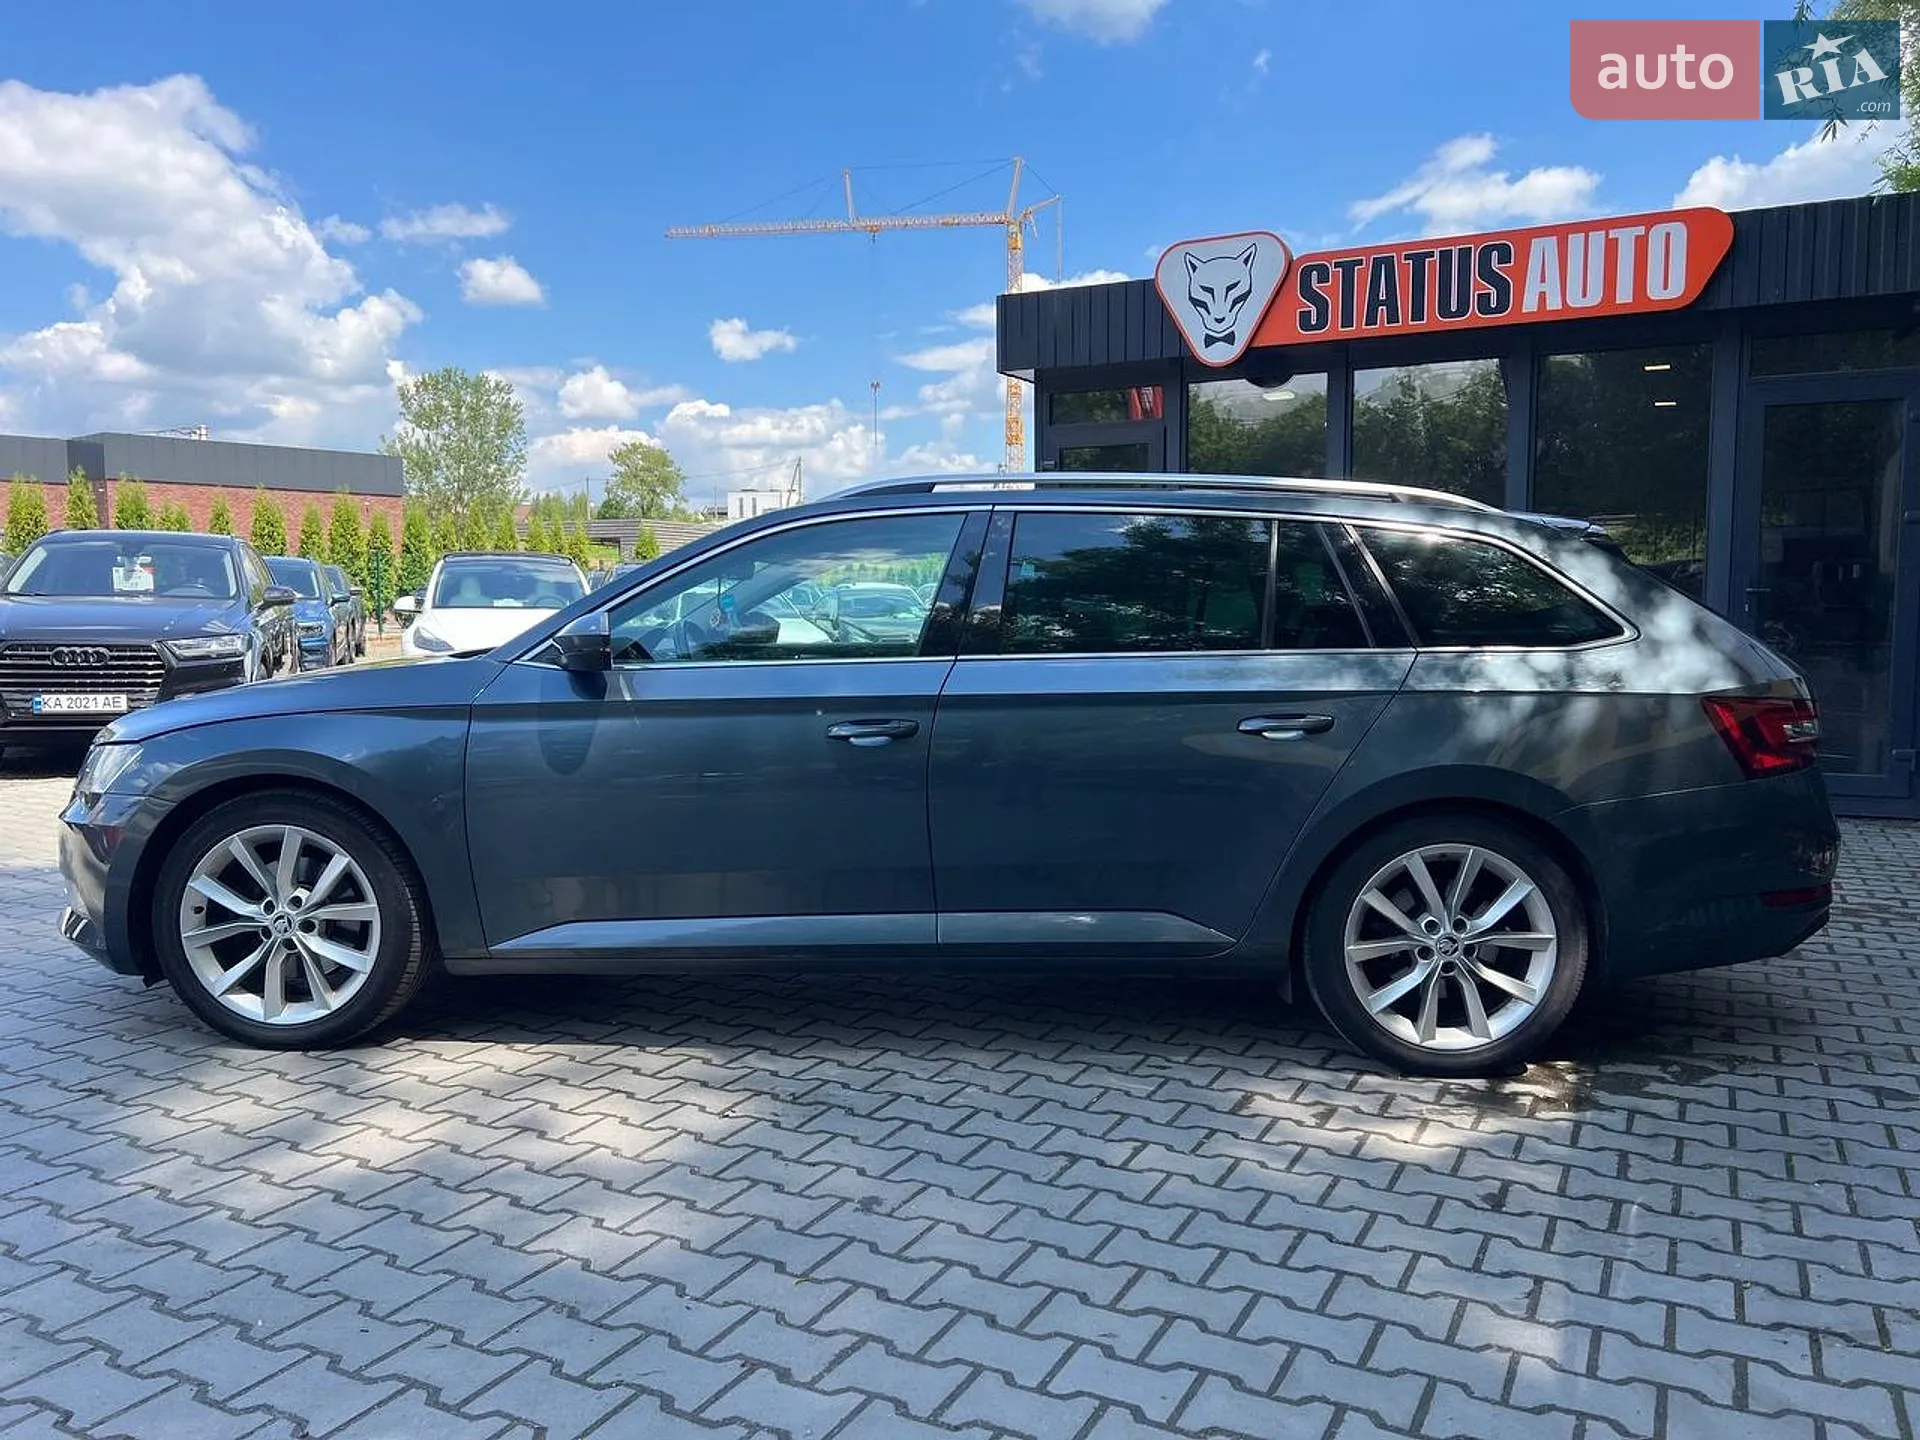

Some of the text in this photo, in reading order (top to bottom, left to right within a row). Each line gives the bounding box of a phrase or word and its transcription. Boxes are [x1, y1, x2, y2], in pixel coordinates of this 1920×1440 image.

[43, 696, 122, 709] KA 2021 AE
